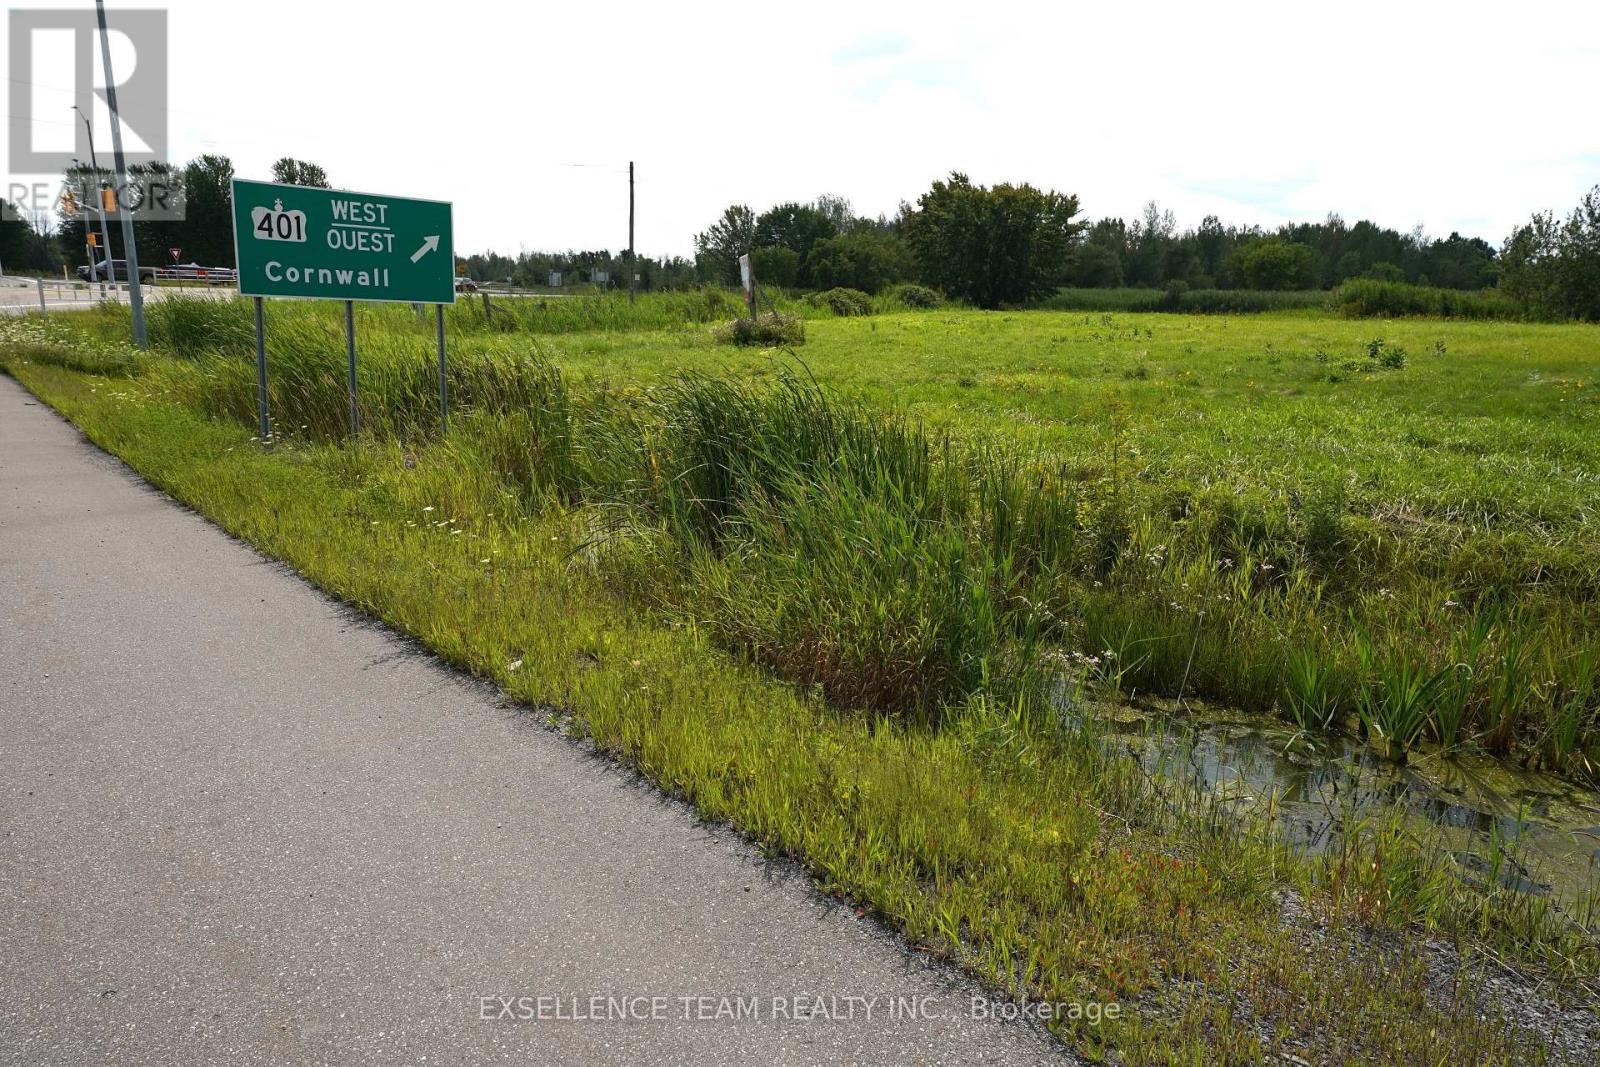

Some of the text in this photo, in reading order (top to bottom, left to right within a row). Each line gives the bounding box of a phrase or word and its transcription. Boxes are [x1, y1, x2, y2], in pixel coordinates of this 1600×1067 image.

[331, 199, 388, 224] WEST
[257, 213, 301, 240] 401
[327, 229, 395, 253] OUEST
[265, 261, 389, 287] Cornwall
